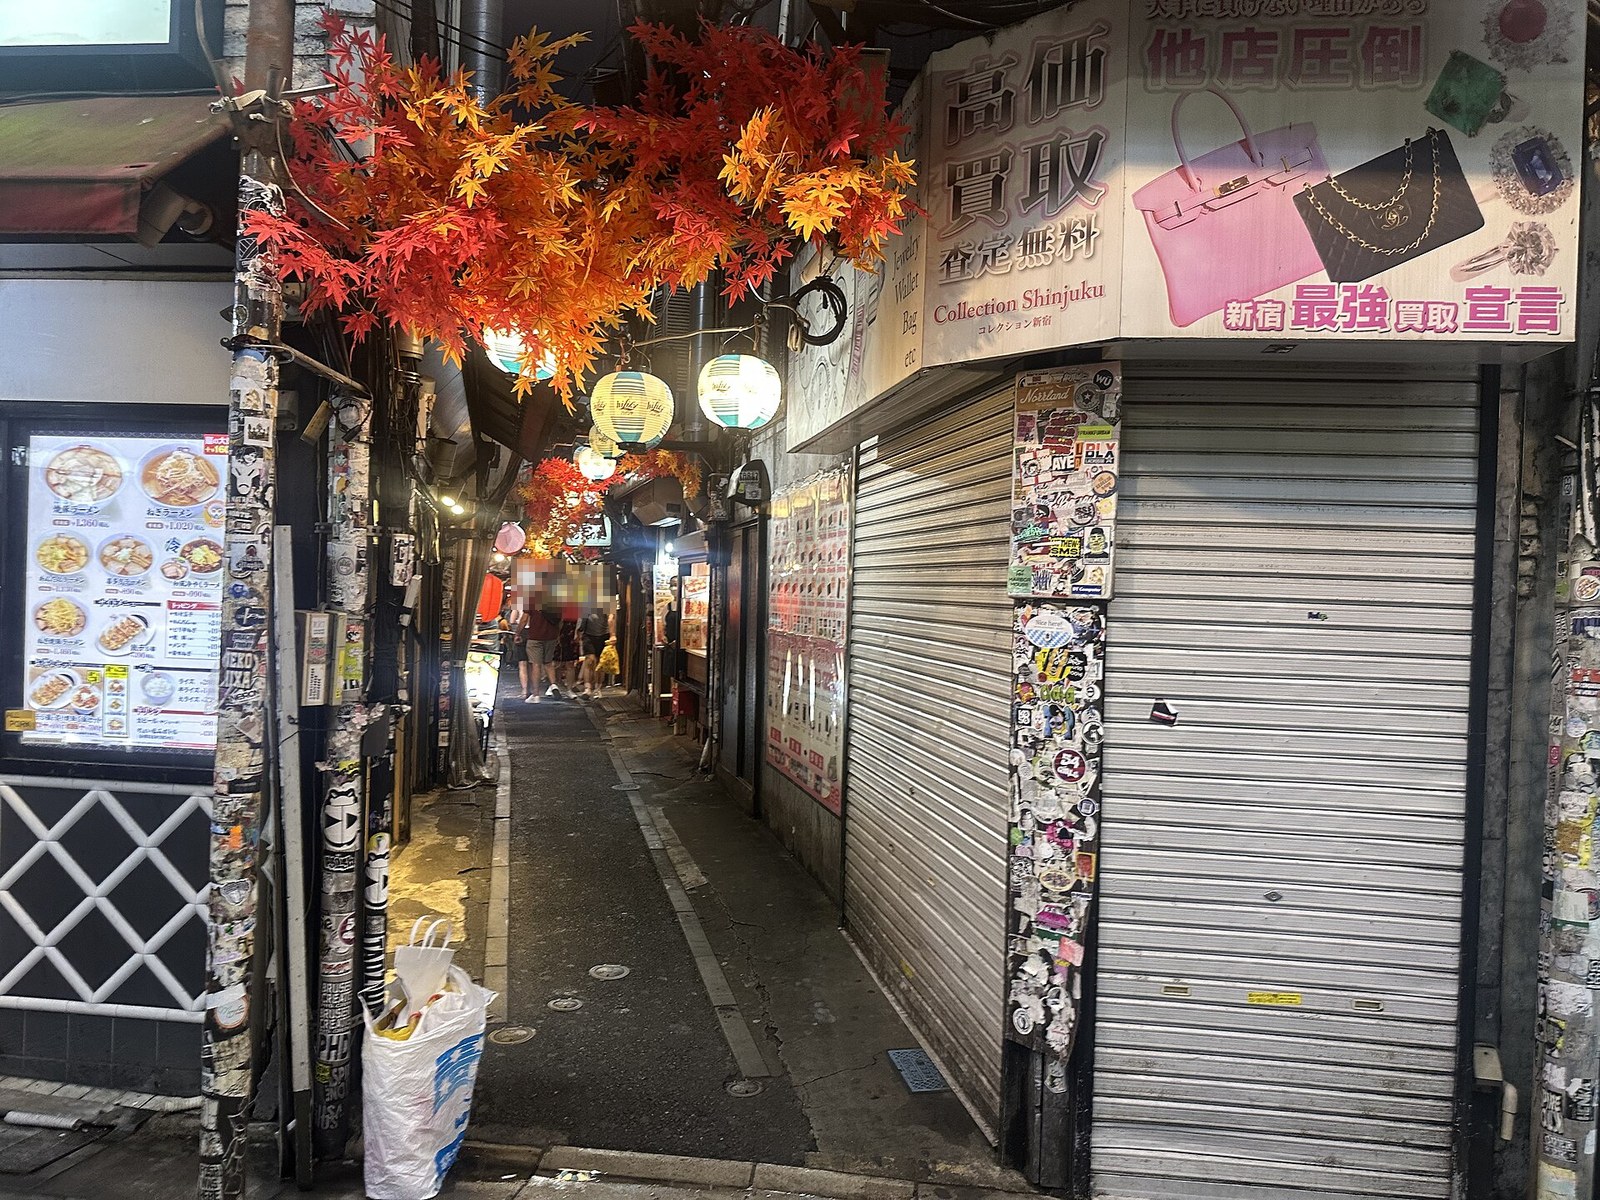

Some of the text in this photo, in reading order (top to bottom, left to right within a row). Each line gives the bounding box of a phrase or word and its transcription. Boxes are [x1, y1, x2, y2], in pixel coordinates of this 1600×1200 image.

[1147, 25, 1422, 87] 他店圧倒
[945, 26, 1107, 146] 高価
[940, 128, 1107, 239] 買取
[892, 234, 921, 280] Jewelry
[938, 212, 1100, 285] 査定無料
[894, 272, 920, 306] Wallet
[933, 280, 1105, 325] Collection Shinjuku
[1223, 283, 1565, 335] 新宿最強買取宣言
[902, 309, 918, 337] Bag
[978, 315, 1052, 335] コレクション新宿
[904, 347, 917, 368] etc
